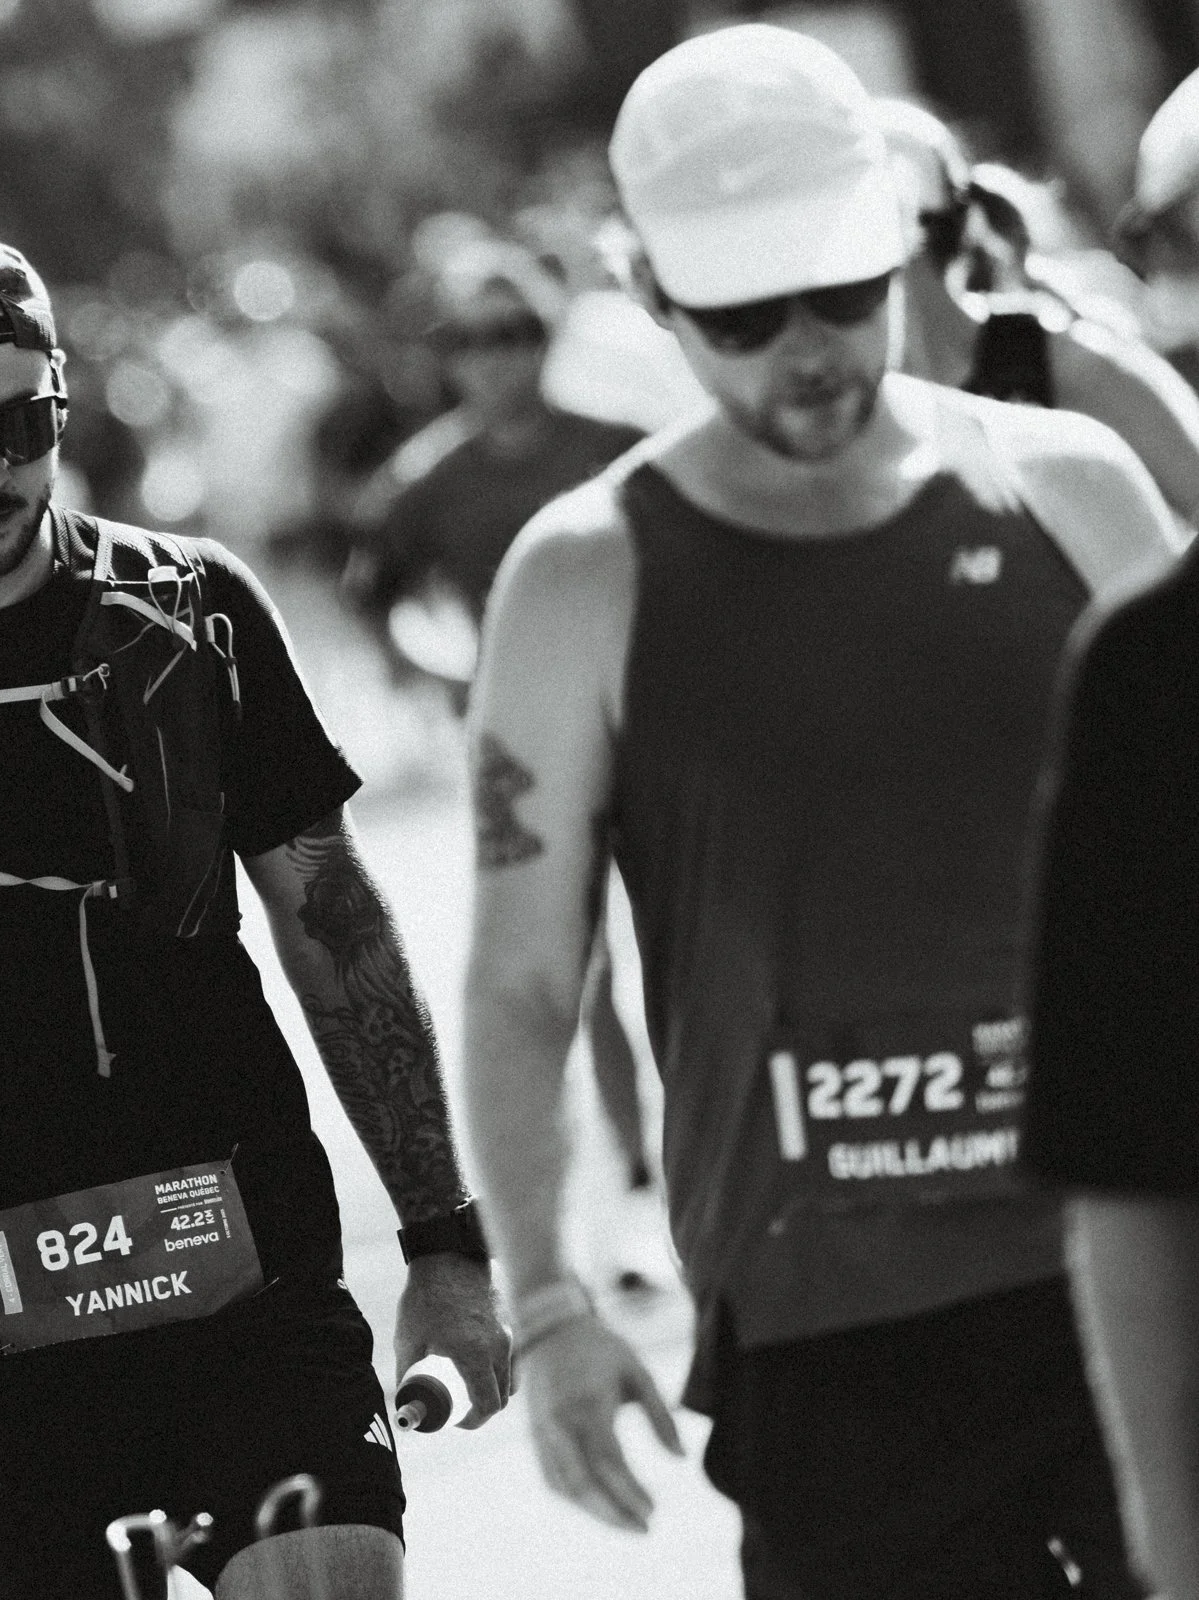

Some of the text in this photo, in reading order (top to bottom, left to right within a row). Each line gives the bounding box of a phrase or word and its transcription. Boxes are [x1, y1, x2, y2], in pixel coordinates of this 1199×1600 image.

[807, 1053, 964, 1118] 2272
[154, 1174, 218, 1195] MARATHON
[157, 1186, 220, 1205] BENEVA QUÉBEC
[170, 1211, 205, 1230] 42.2
[36, 1215, 133, 1271] 824
[164, 1231, 219, 1252] beneva
[65, 1270, 192, 1317] YANNICK
